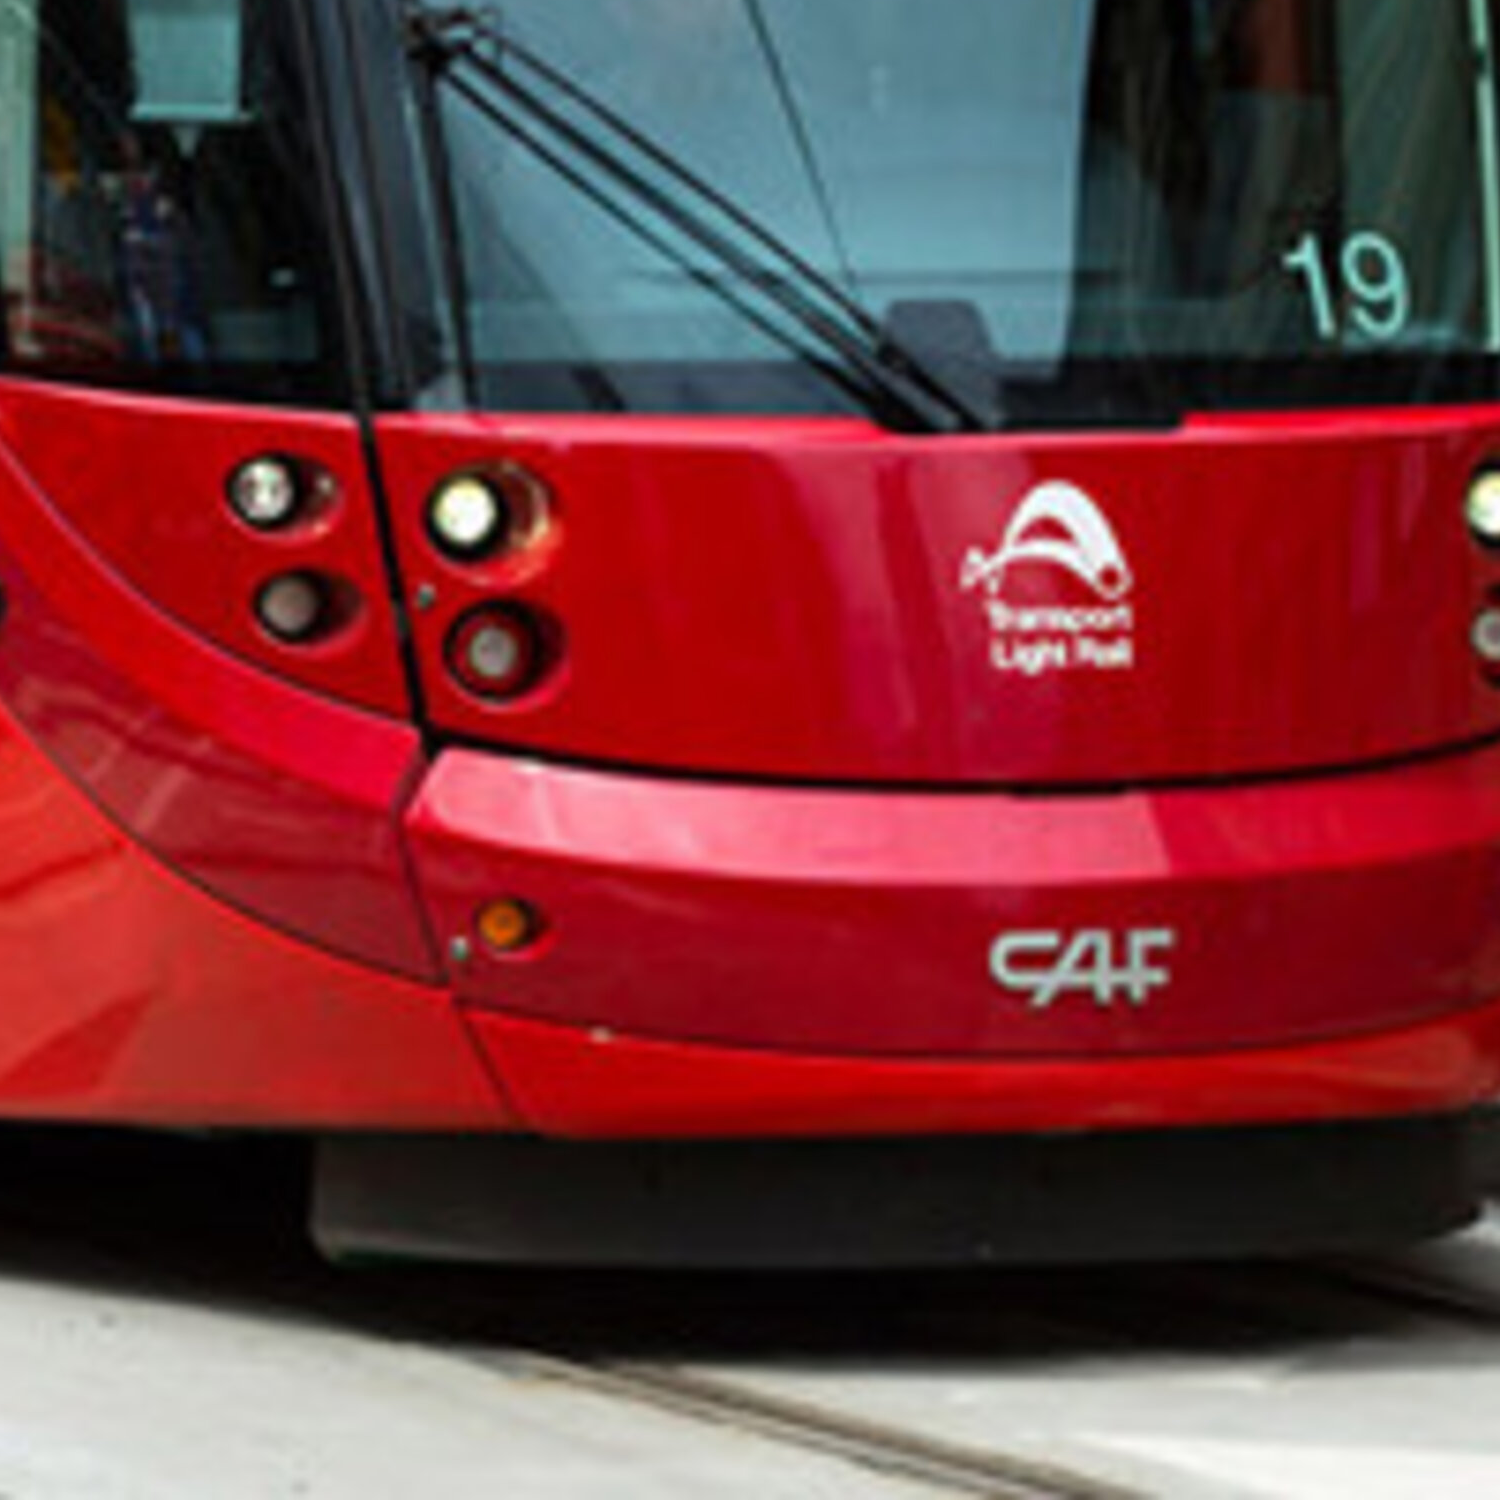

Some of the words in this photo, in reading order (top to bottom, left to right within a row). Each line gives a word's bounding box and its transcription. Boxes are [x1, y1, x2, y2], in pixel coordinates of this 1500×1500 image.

[1281, 230, 1411, 340] 19
[987, 601, 1135, 633] Transport
[990, 636, 1067, 675] Light
[1073, 637, 1135, 671] Rail
[989, 928, 1177, 1008] CAF
